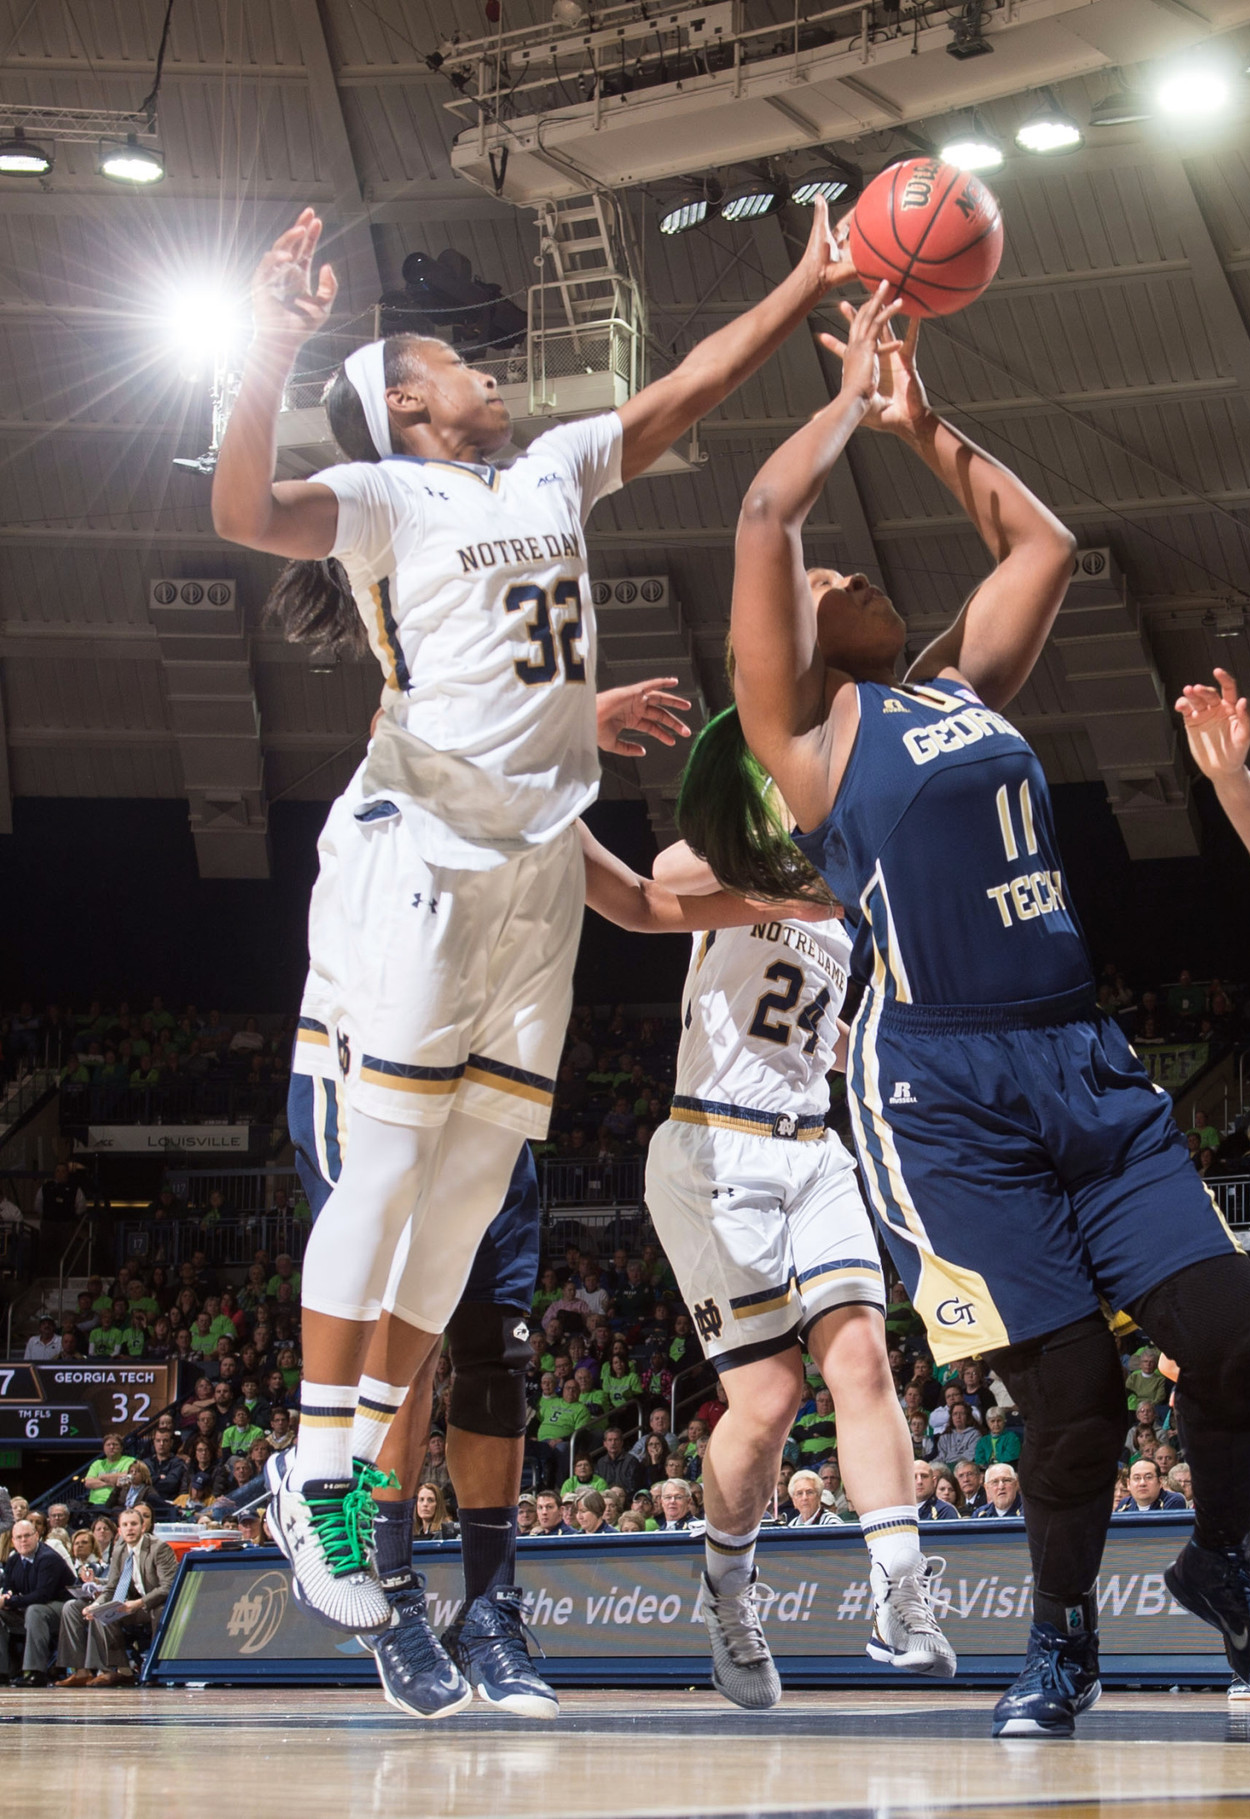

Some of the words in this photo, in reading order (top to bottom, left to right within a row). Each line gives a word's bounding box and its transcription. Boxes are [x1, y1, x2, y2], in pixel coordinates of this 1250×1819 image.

[537, 472, 560, 487] ACC
[456, 537, 544, 573] NOTRE
[543, 532, 581, 559] DAM
[503, 578, 588, 688] 32
[996, 778, 1038, 863] 11
[986, 870, 1067, 928] TECH
[750, 921, 816, 959] NOTRE
[816, 946, 848, 995] DAME
[747, 958, 832, 1057] 24
[147, 1136, 241, 1147] LOUISVILLE
[133, 1238, 143, 1249] 17
[54, 1372, 116, 1383] GEORGIA
[119, 1372, 154, 1383] TECH
[18, 1410, 32, 1418] TM
[111, 1392, 151, 1423] 32
[25, 1419, 40, 1438] 6
[523, 1588, 573, 1626] the
[585, 1586, 681, 1624] video
